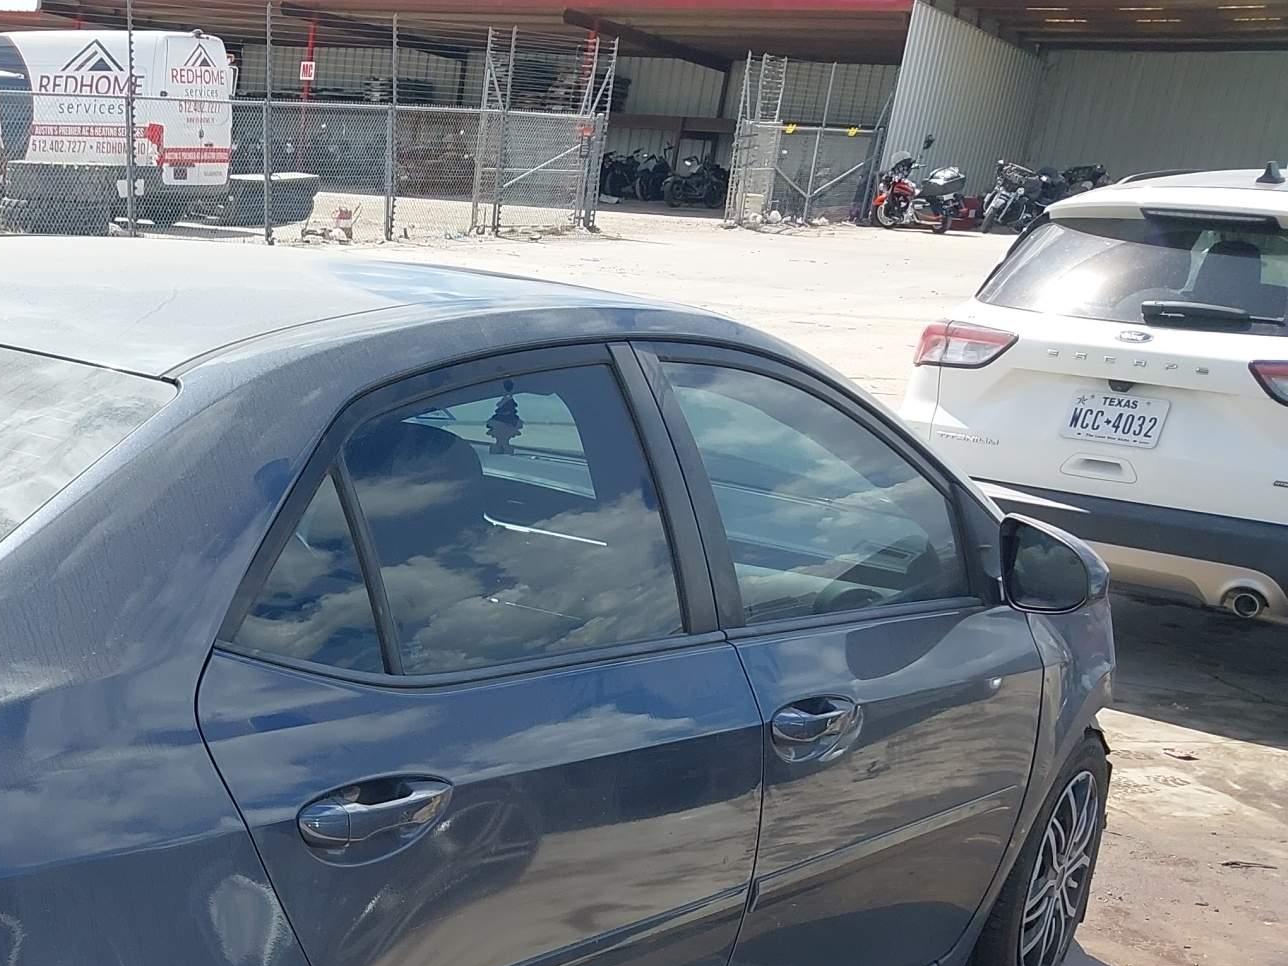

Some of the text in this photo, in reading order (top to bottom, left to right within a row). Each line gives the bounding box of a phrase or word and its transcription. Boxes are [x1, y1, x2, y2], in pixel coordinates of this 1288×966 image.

[171, 68, 225, 86] REDHOME
[184, 86, 219, 98] services
[58, 99, 125, 115] services
[32, 139, 87, 153] 512.402.7277
[1102, 396, 1138, 409] TEXAS
